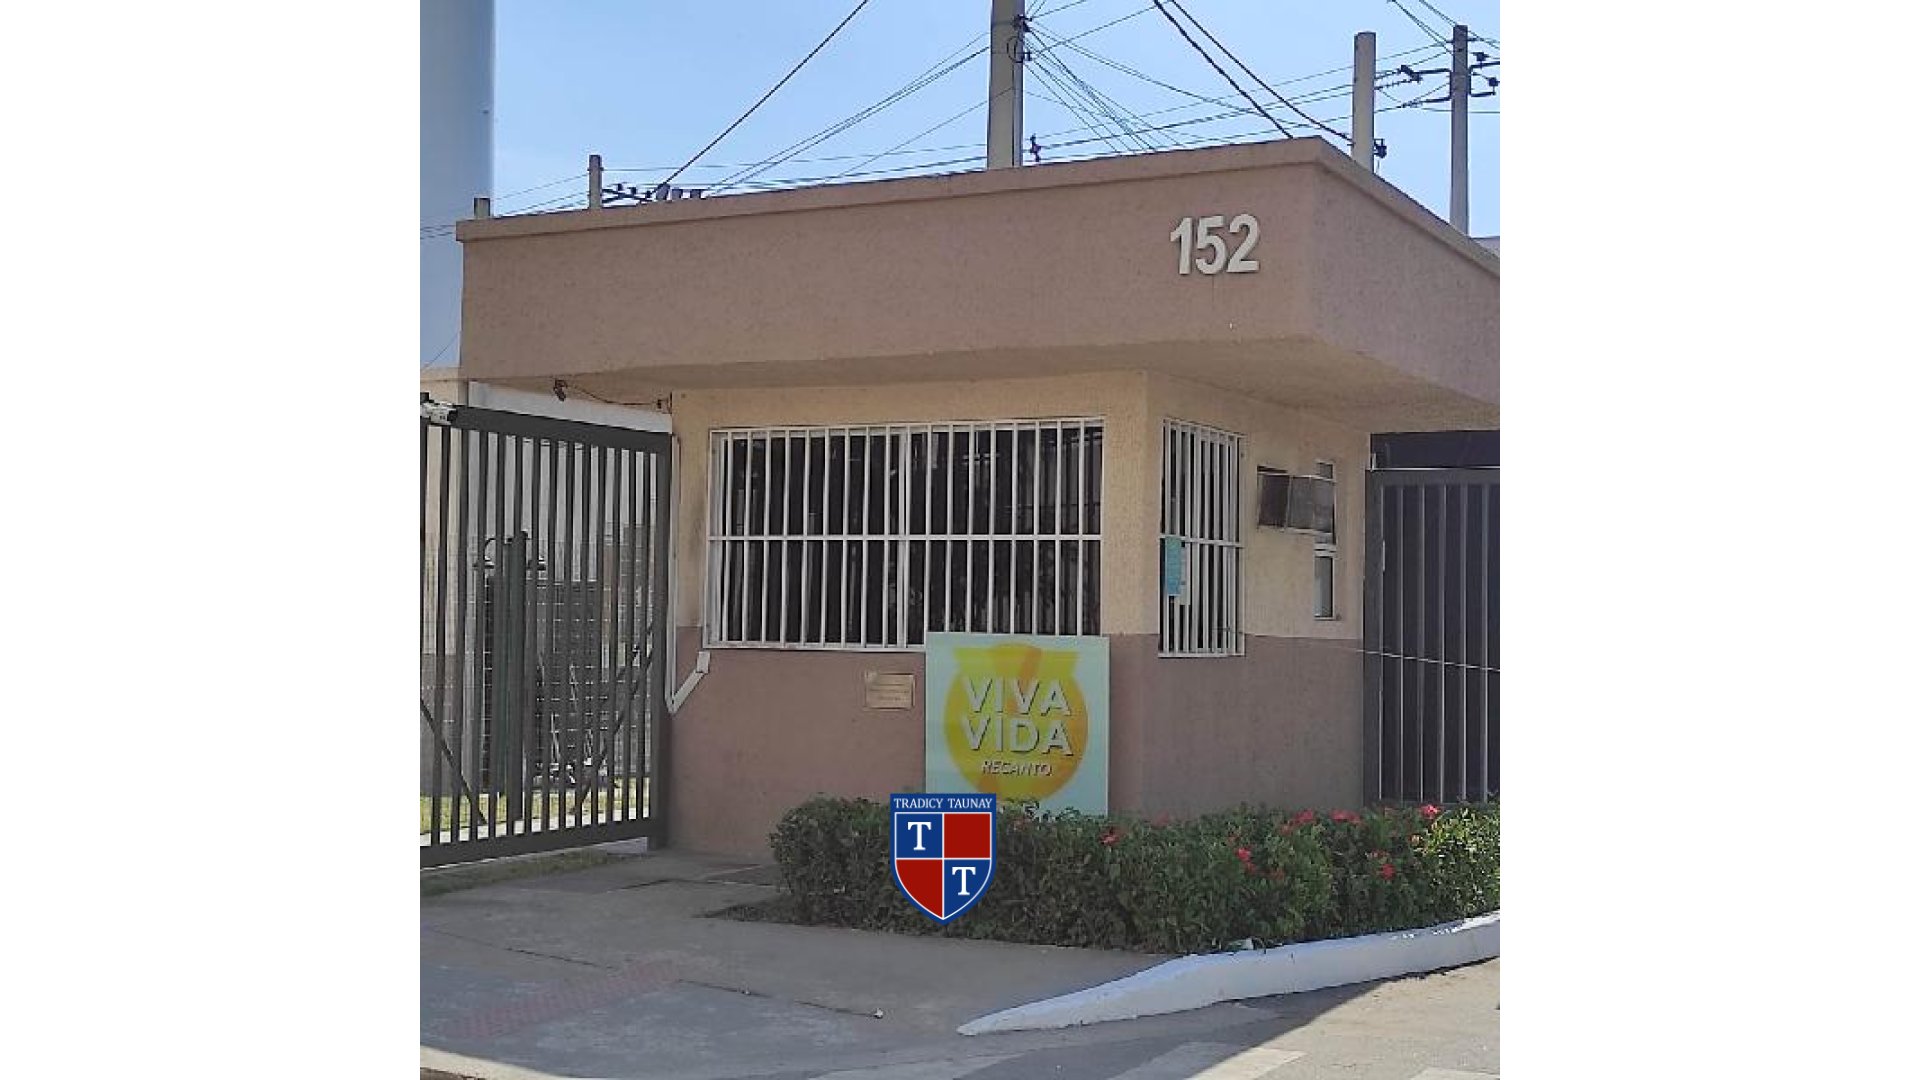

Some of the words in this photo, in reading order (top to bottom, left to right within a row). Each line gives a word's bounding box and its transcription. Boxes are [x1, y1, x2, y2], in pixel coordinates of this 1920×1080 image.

[1169, 213, 1260, 275] 152
[964, 676, 1072, 716] VIVA
[961, 715, 1074, 756] VIDA
[982, 760, 1053, 776] RECANTO
